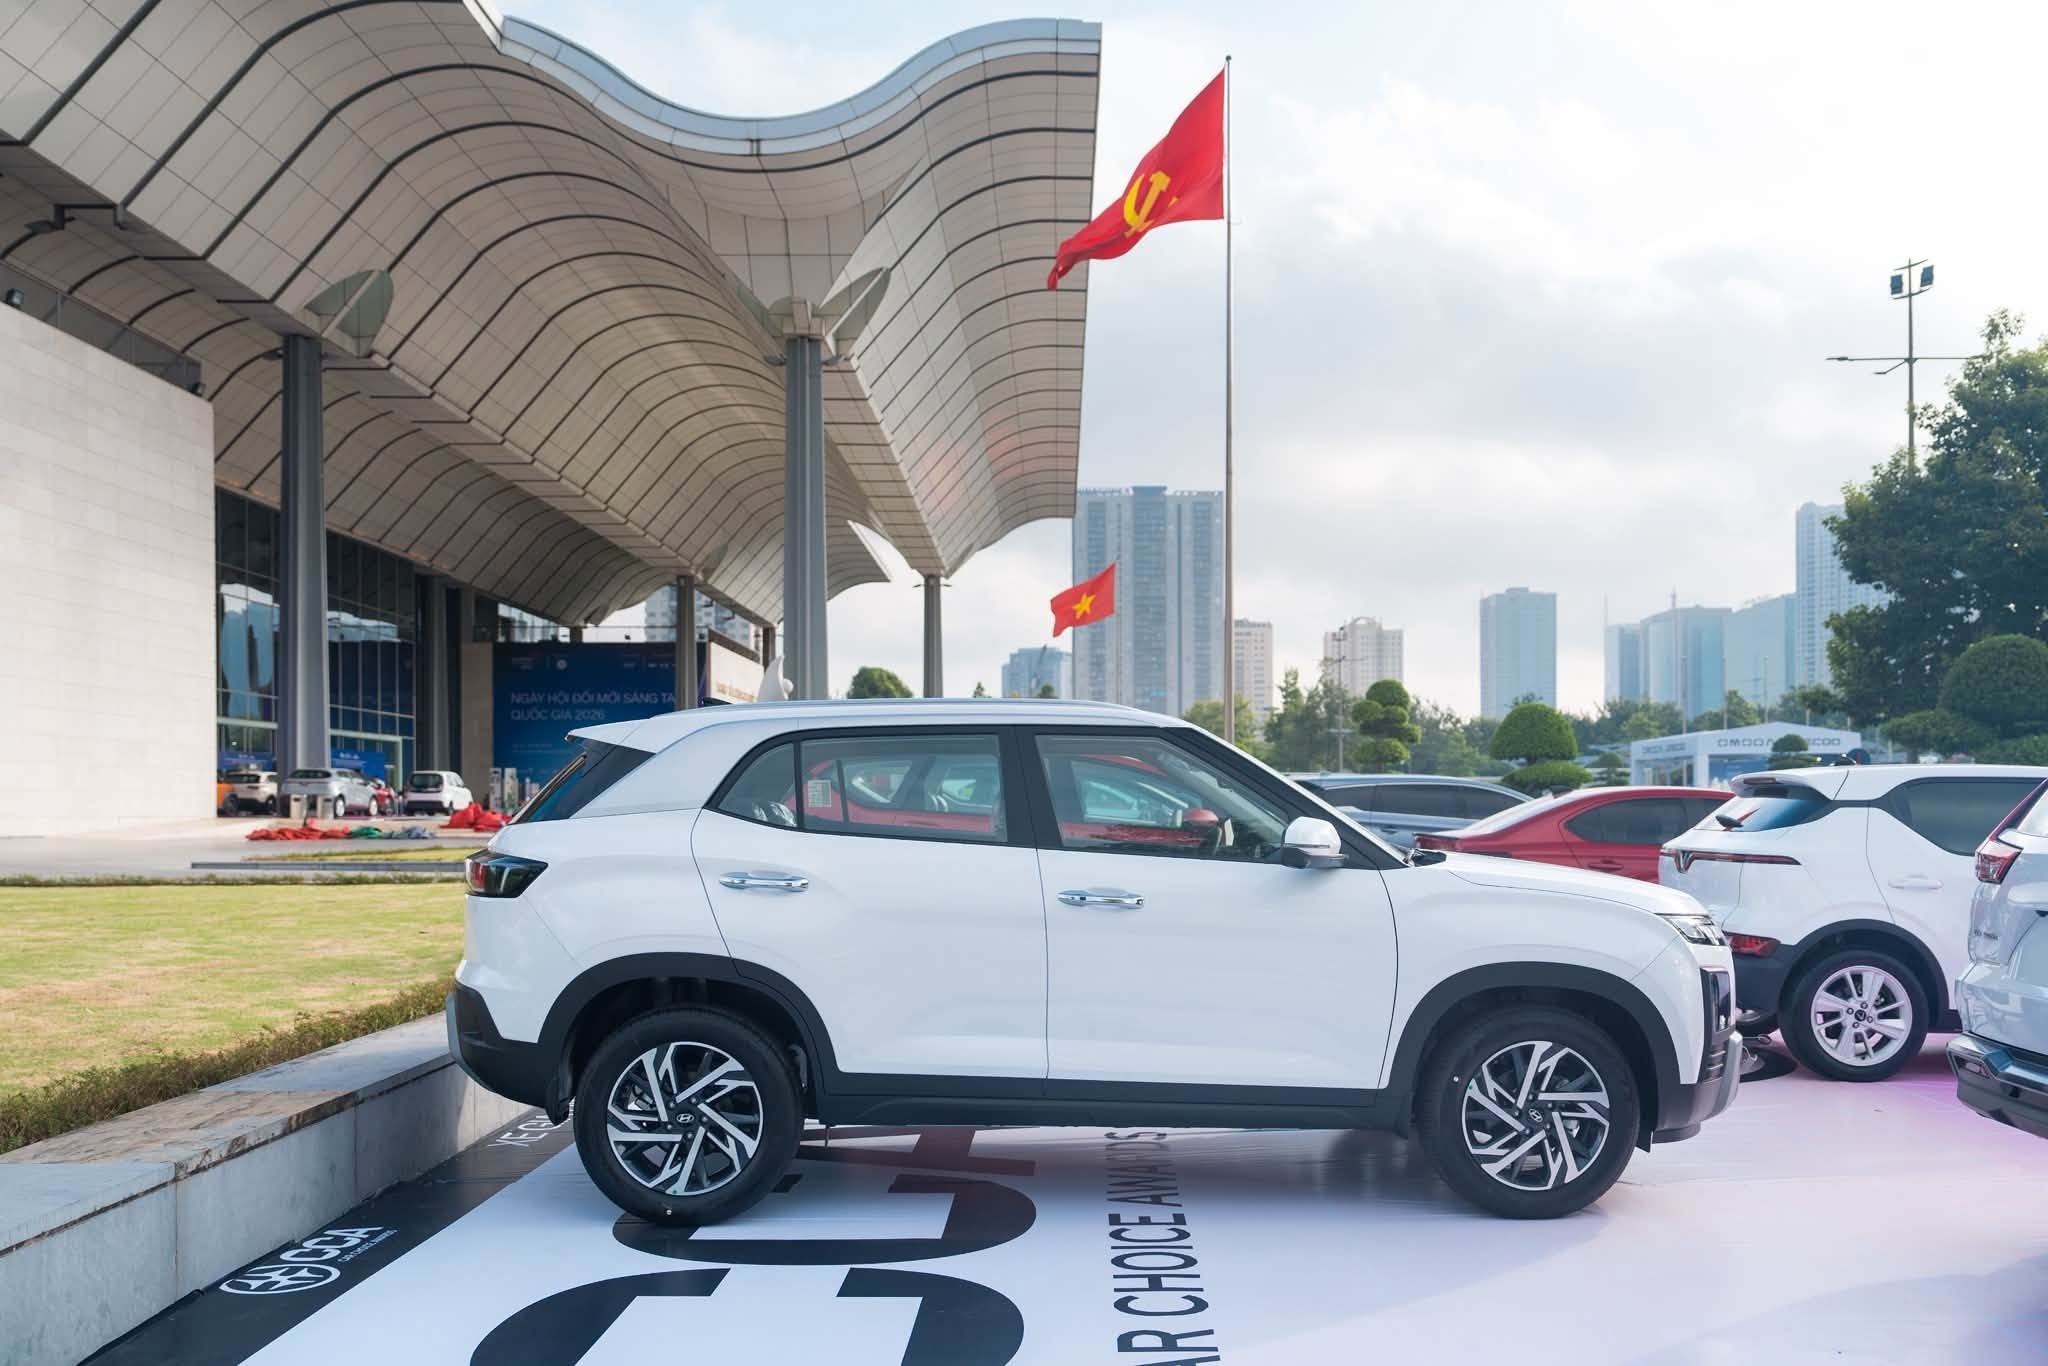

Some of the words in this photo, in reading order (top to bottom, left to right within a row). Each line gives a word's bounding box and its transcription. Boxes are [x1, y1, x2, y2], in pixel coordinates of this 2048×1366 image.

[551, 708, 573, 721] GIA
[279, 1226, 384, 1262] CCA
[1108, 1213, 1209, 1316] CHOICE
